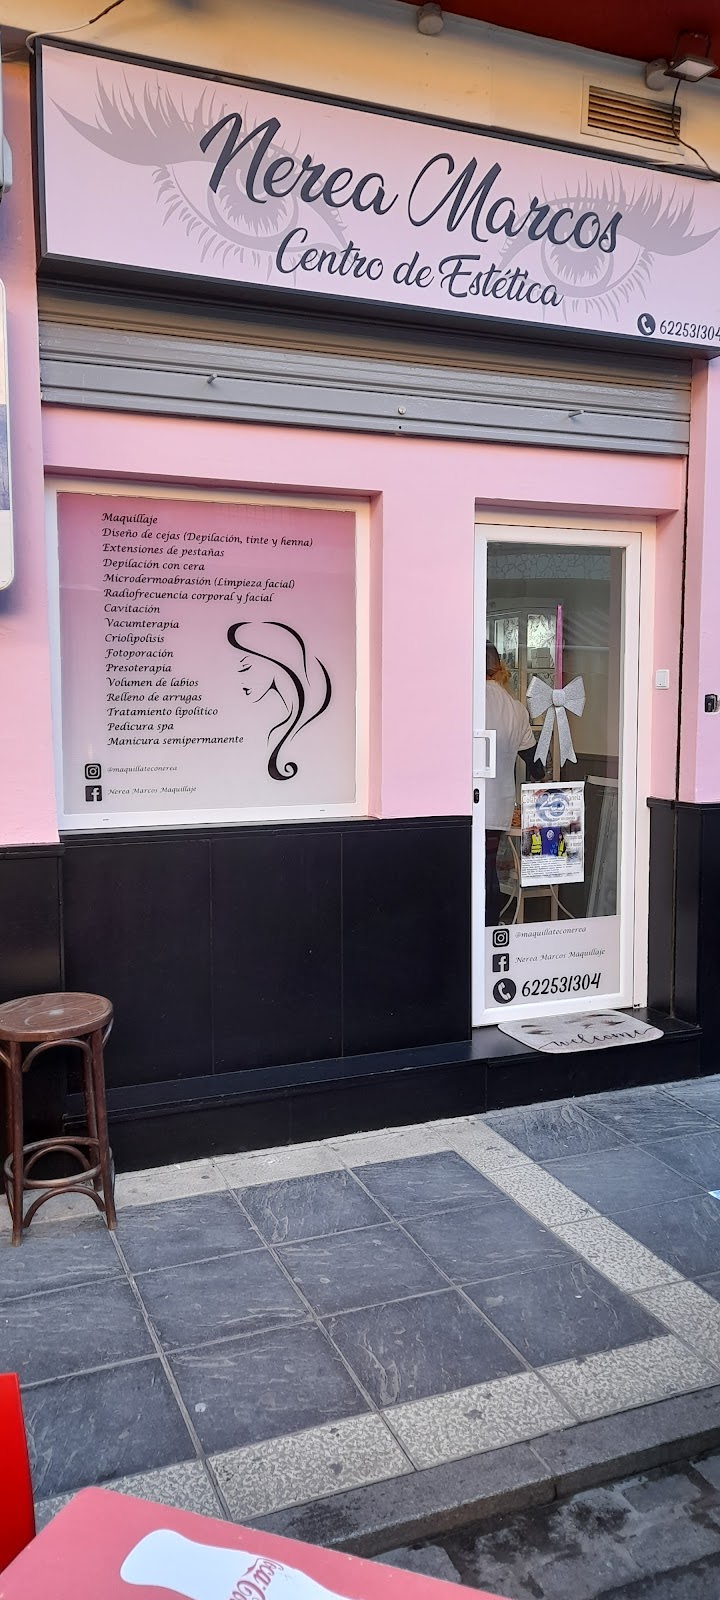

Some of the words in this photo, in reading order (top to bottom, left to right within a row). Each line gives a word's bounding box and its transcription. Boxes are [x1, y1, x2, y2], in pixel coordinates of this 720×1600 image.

[199, 112, 398, 215] Nerea
[407, 151, 623, 254] Marcos
[275, 227, 384, 281] Centro
[392, 251, 435, 288] de
[438, 254, 564, 307] Estética
[100, 512, 158, 527] Maquillaje
[101, 527, 139, 539] Diseño
[140, 528, 153, 539] de
[155, 530, 181, 543] cejas
[183, 531, 243, 545] (Depilación,
[245, 535, 269, 545] tinte
[271, 538, 279, 548] y
[280, 535, 314, 548] henna)
[101, 542, 164, 555] Extensiones
[166, 544, 179, 556] de
[179, 547, 225, 559] pestañas
[102, 557, 161, 571] Depilación
[161, 562, 181, 571] con
[182, 563, 206, 571] cera
[102, 573, 212, 586] Microdermoabrasión
[213, 576, 263, 590] (Limpieza
[262, 577, 296, 591] facial)
[103, 587, 190, 602] Radiofrecuencia
[190, 591, 236, 604] corporal
[235, 594, 243, 605] y
[242, 591, 275, 605] facial
[103, 603, 161, 614] Cavitación
[103, 617, 181, 631] Vacumterapia
[104, 632, 165, 646] Criolipolisis
[103, 648, 175, 661] Fotoporación
[105, 663, 173, 676] Presoterapia
[105, 676, 154, 687] Volumen
[155, 676, 168, 688] de
[170, 676, 200, 688] labios
[105, 691, 146, 702] Relleno
[147, 691, 160, 702] de
[162, 694, 203, 705] arrugas
[104, 706, 173, 717] Tratamiento
[106, 720, 155, 732] Pedicura
[156, 723, 175, 734] spa
[106, 736, 161, 746] Manicura
[161, 735, 244, 748] semipermanente
[107, 788, 130, 796] Nerea
[131, 787, 159, 795] Marcos
[159, 784, 197, 795] Maquillaje
[514, 955, 538, 964] Nerea
[539, 952, 567, 962] Marcos
[567, 947, 606, 959] Maquillaje
[521, 972, 602, 998] 622531304
